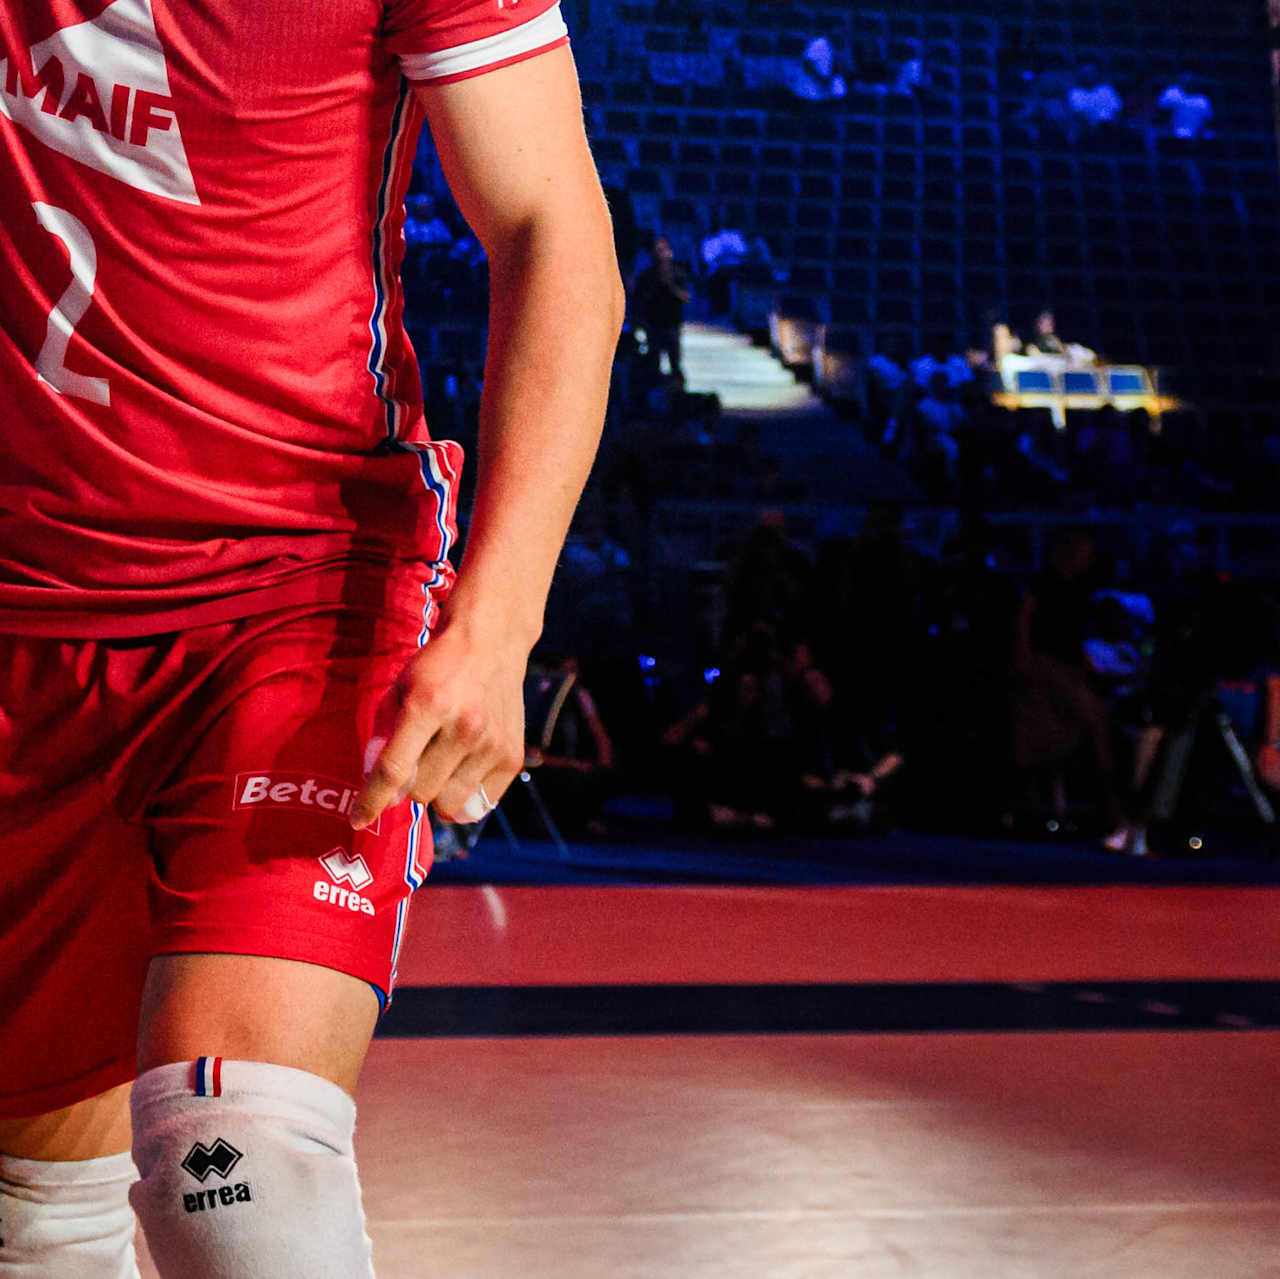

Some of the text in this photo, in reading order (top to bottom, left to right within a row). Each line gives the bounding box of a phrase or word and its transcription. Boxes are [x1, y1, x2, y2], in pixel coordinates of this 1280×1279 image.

[5, 53, 173, 147] MAIF
[32, 201, 111, 407] 2
[313, 881, 375, 916] errea
[183, 1183, 251, 1213] errea
